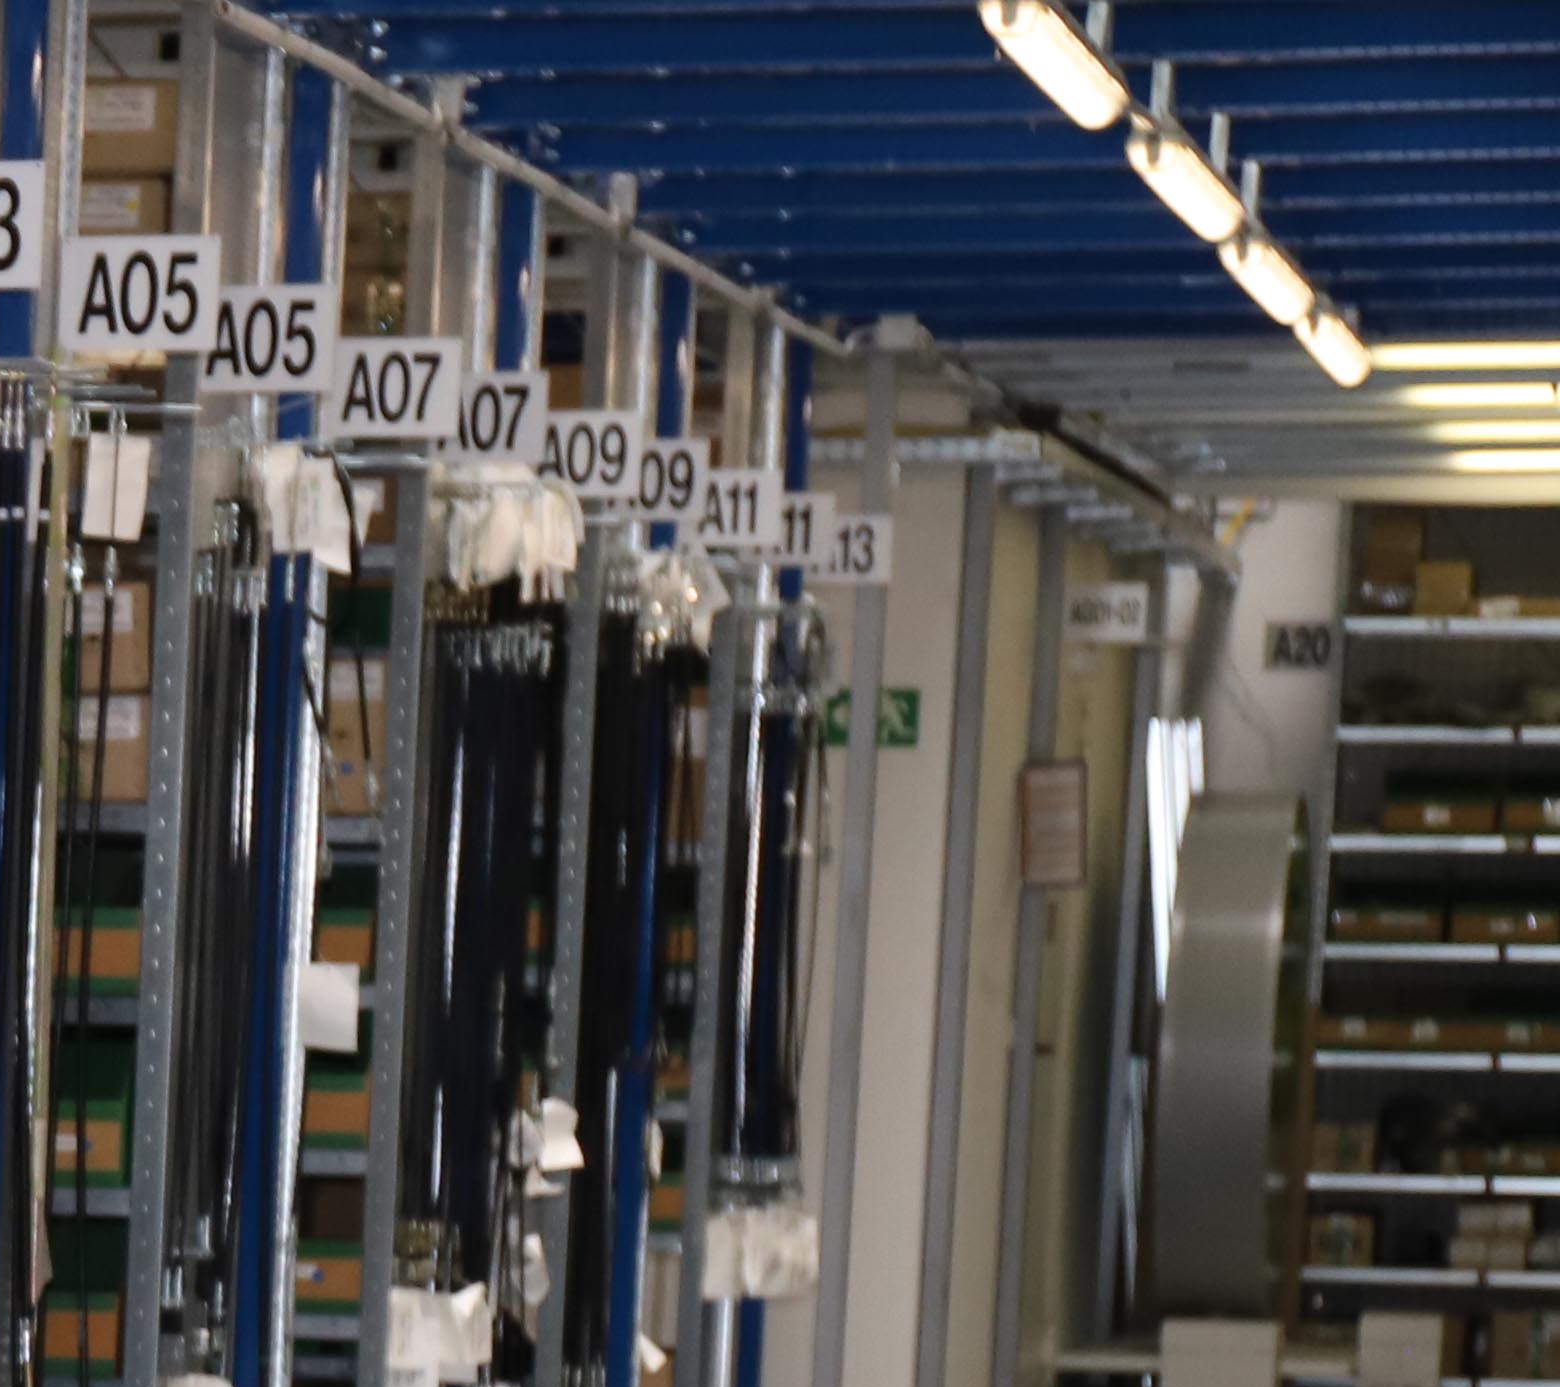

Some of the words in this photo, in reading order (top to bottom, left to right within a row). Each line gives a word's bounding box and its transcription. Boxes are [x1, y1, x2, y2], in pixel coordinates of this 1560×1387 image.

[78, 250, 199, 335] A05
[206, 300, 315, 377] A05
[342, 351, 442, 423] A07
[538, 423, 627, 485] A09
[639, 449, 694, 510] 09
[698, 481, 758, 534] A11
[782, 503, 811, 554] 11
[839, 523, 875, 574] 13
